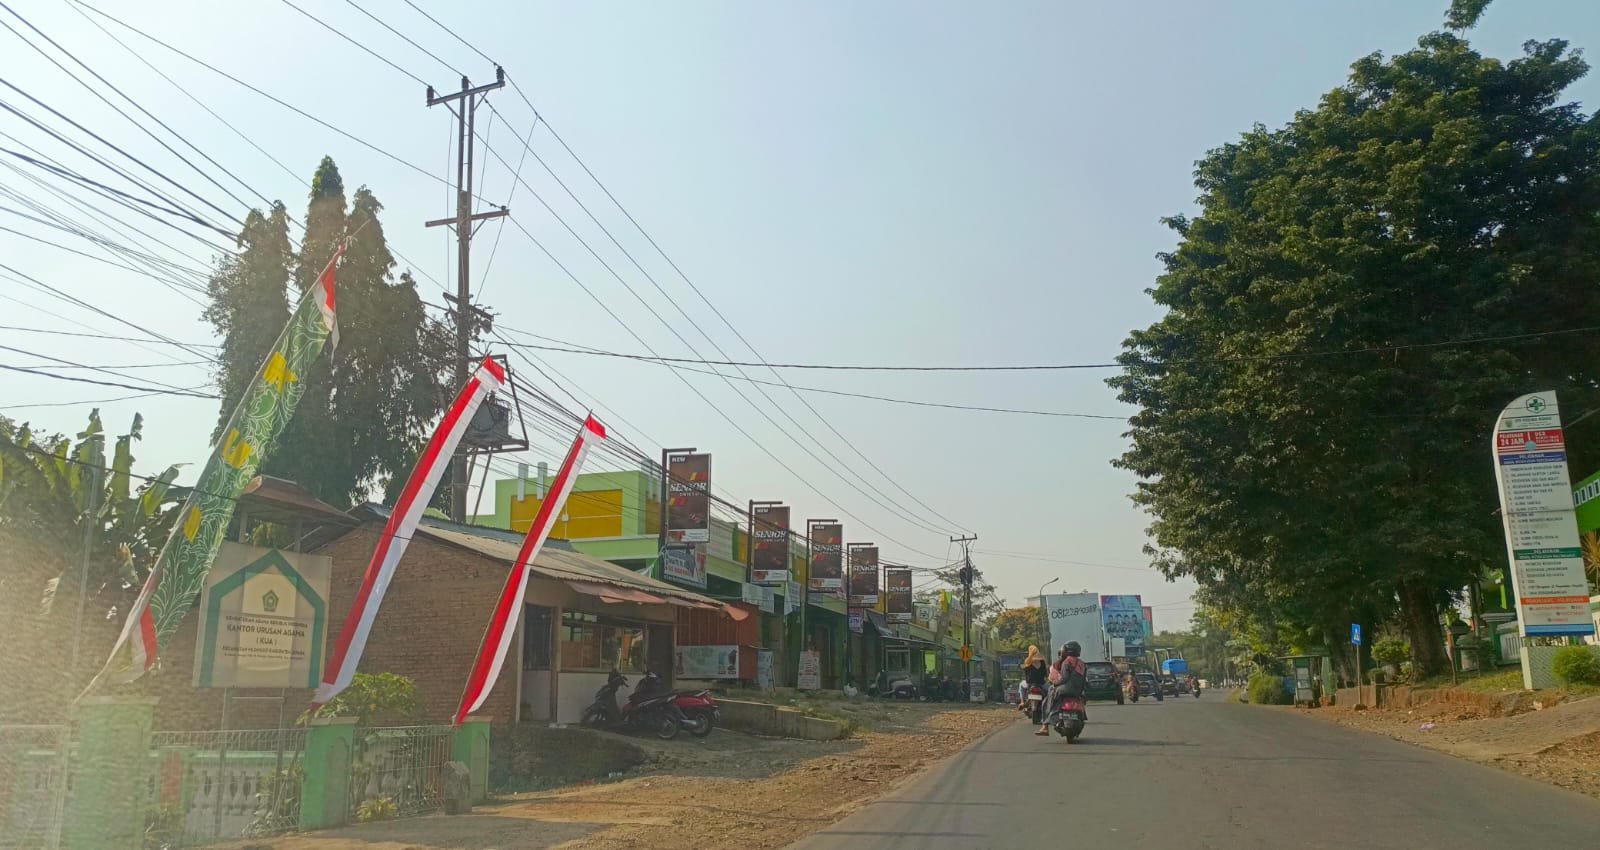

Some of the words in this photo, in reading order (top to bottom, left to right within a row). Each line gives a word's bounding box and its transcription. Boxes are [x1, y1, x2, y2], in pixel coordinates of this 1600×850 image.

[670, 482, 706, 492] SENIOR
[755, 529, 786, 539] SENIOR
[226, 624, 255, 633] KANTOR
[256, 626, 282, 635] URUSAN
[283, 629, 305, 637] AGAMA
